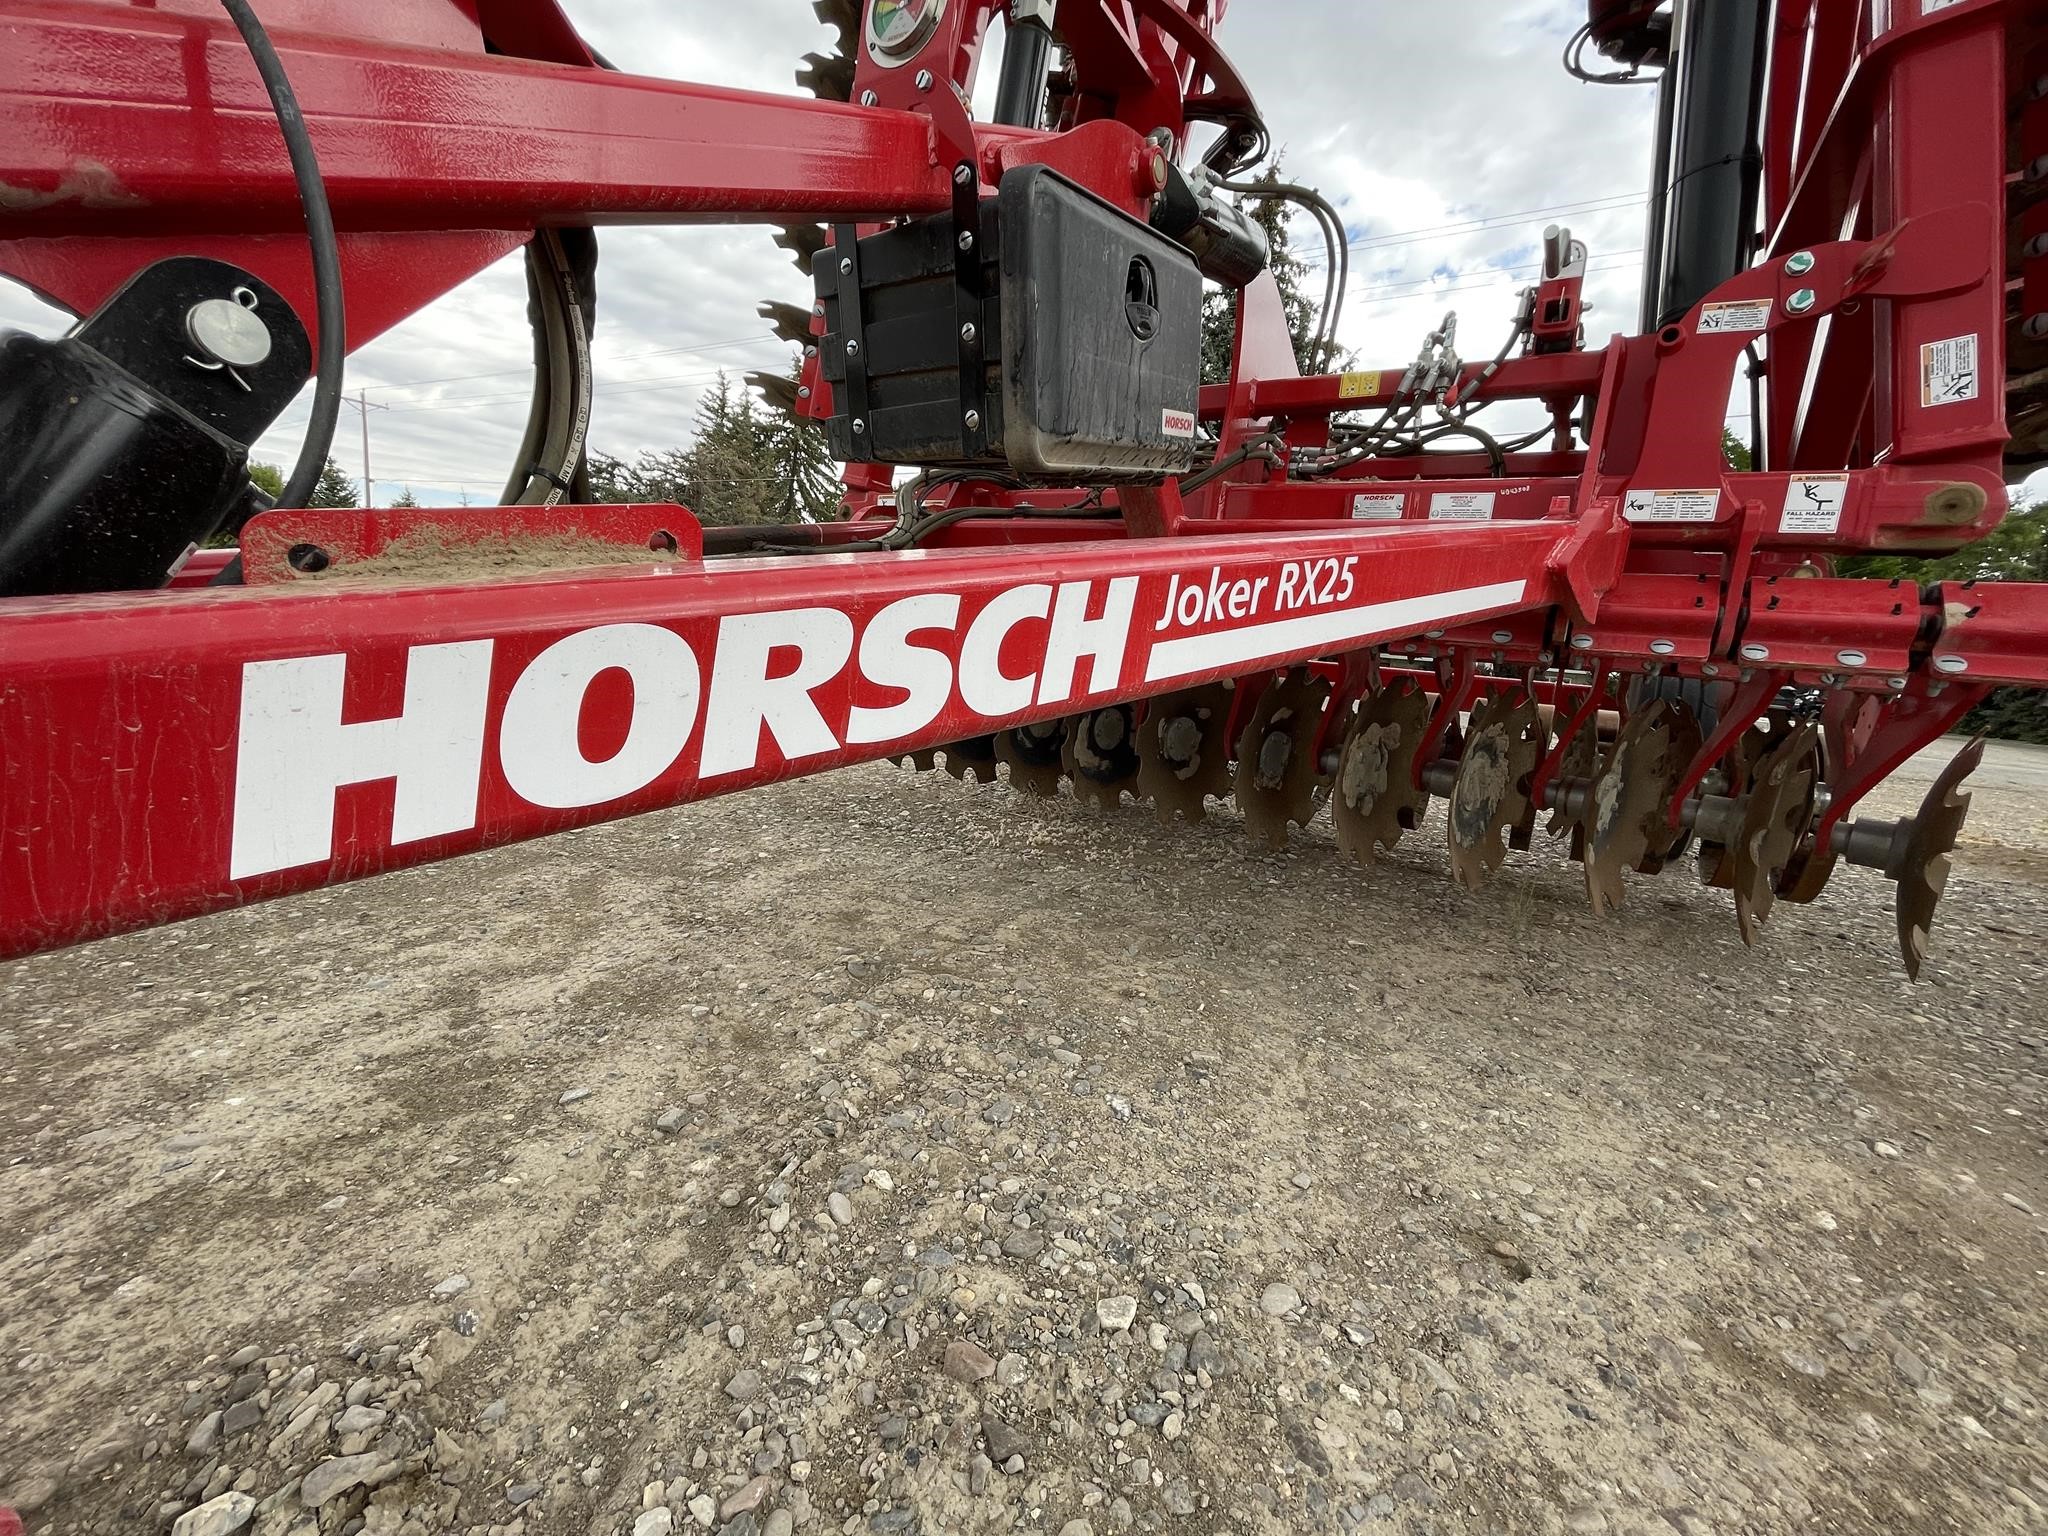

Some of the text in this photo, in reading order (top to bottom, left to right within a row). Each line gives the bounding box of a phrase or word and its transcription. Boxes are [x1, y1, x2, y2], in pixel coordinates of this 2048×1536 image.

[1164, 415, 1193, 431] HORSCH
[1155, 556, 1359, 631] Joker RX25
[230, 576, 1139, 880] HORSCH
